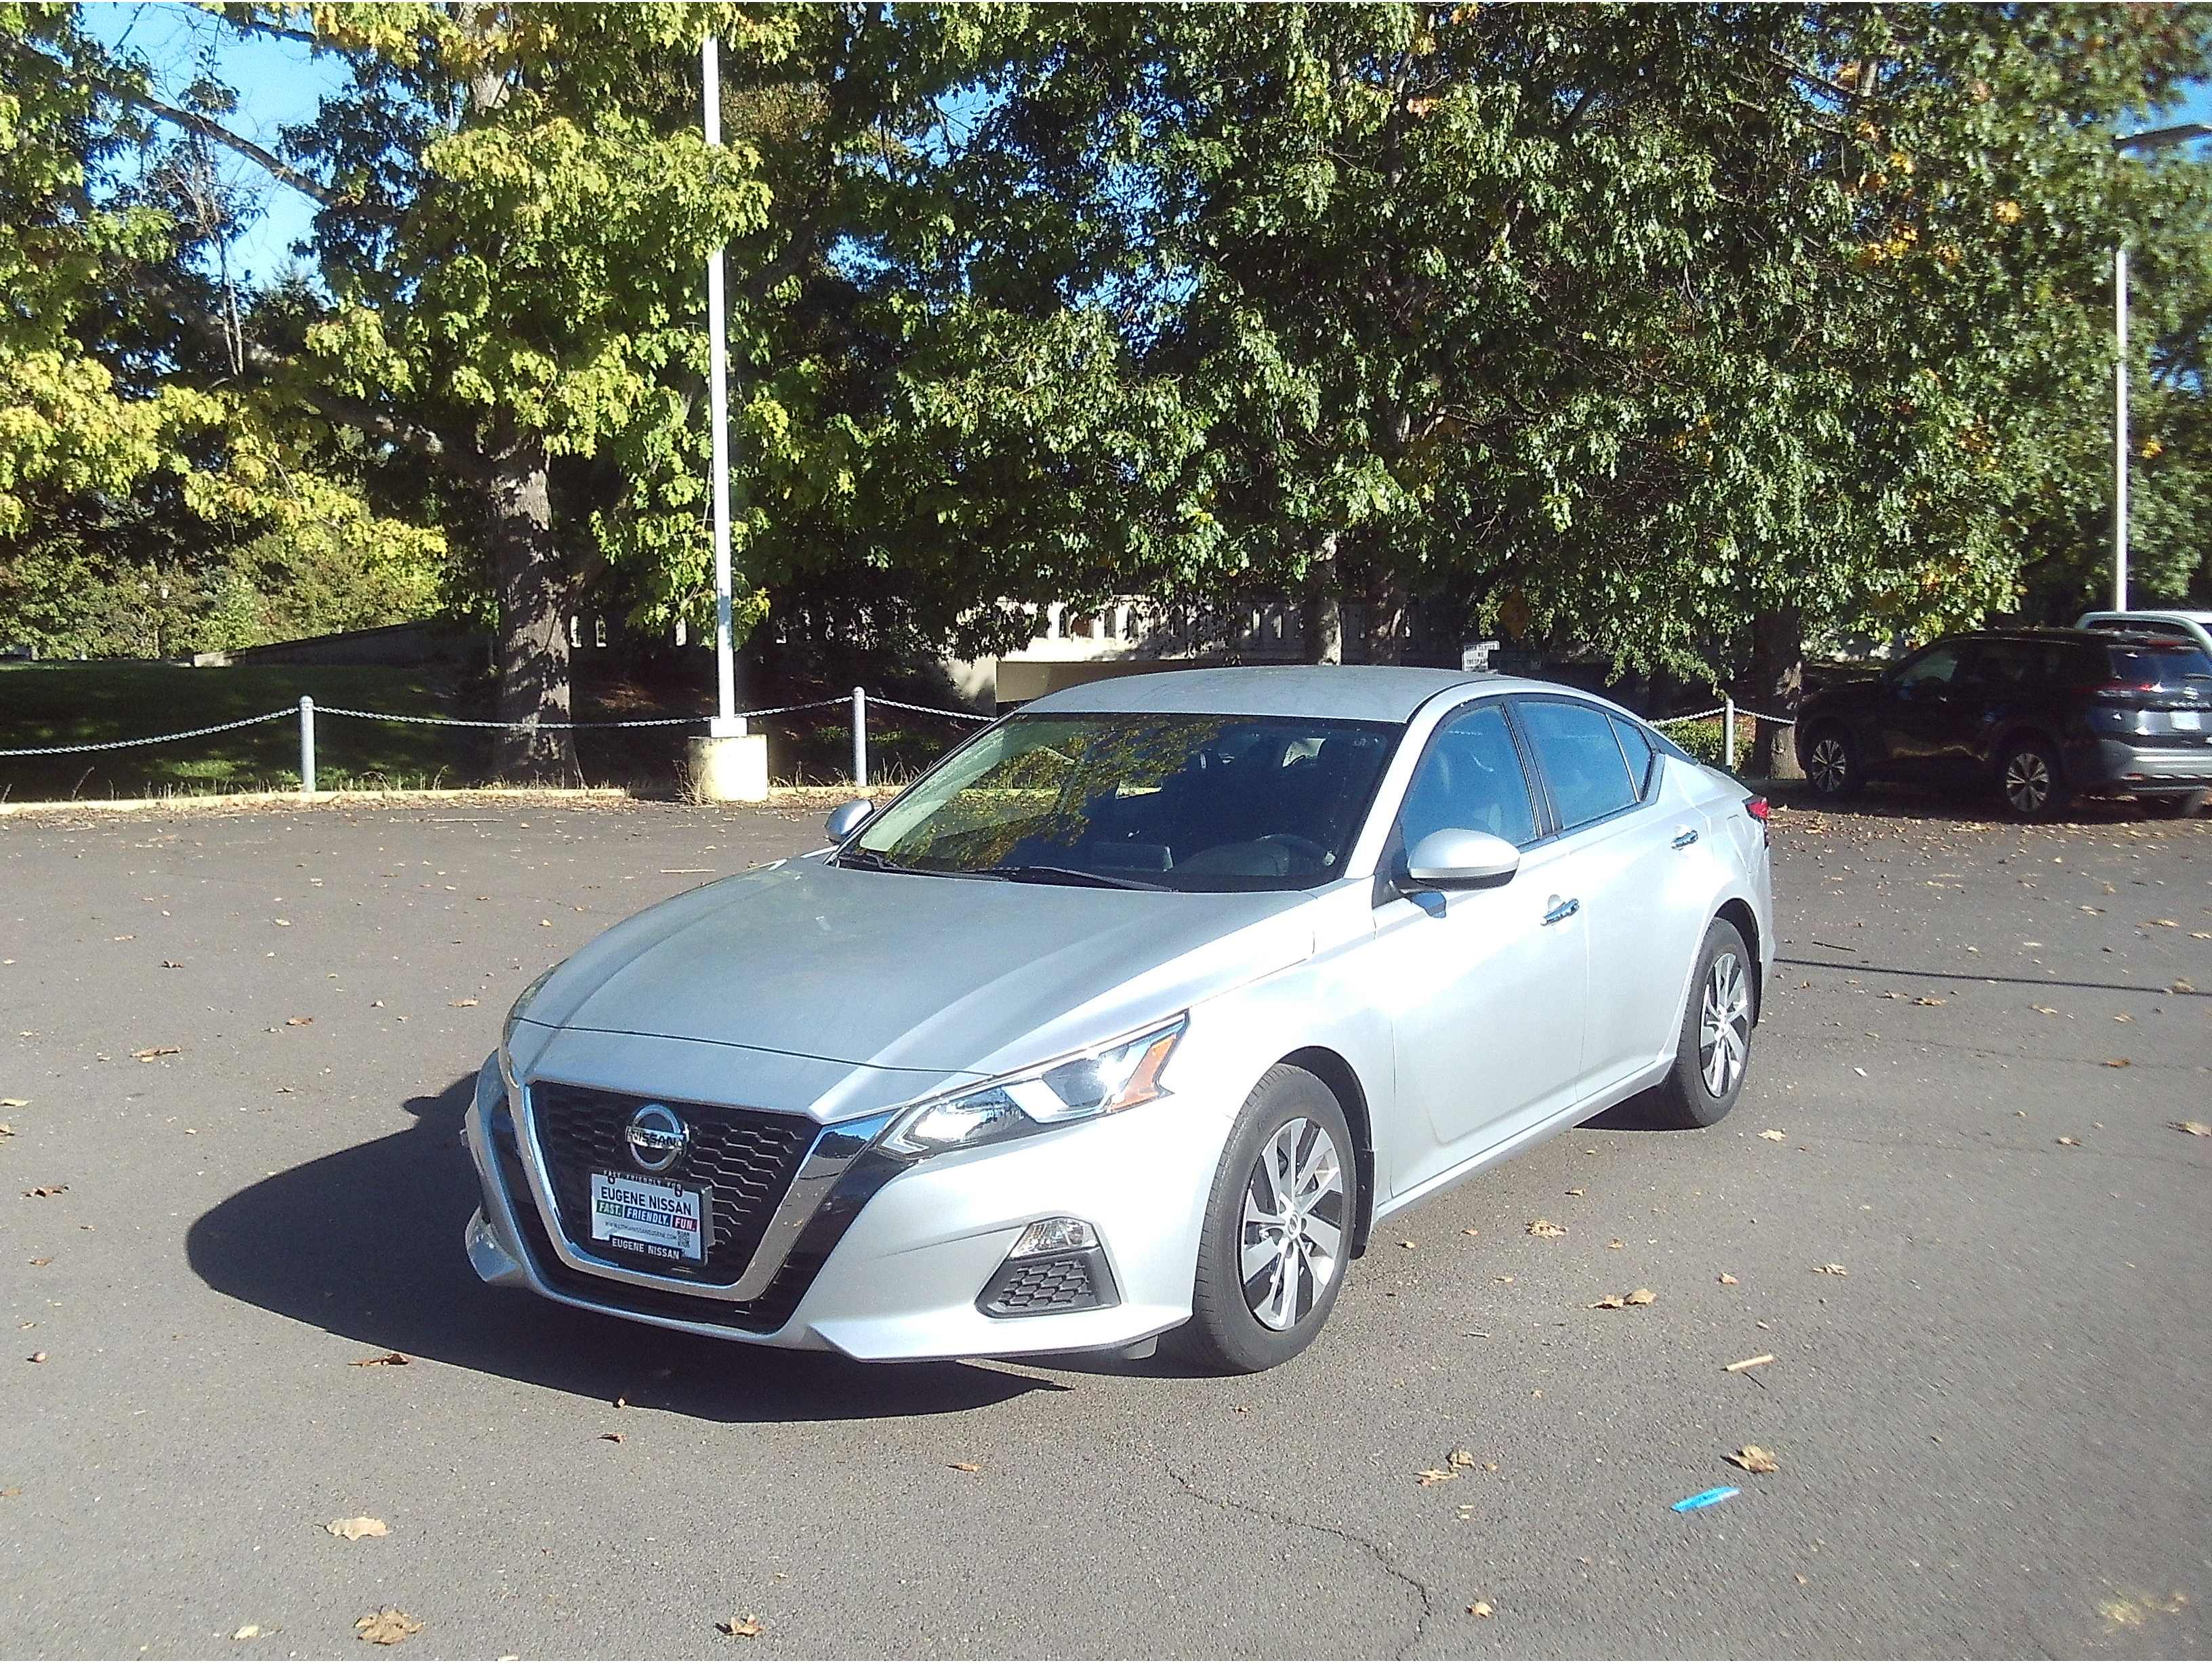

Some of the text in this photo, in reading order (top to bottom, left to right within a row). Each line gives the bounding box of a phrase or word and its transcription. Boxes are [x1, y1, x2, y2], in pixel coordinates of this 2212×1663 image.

[630, 1130, 677, 1147] NISSAN
[601, 1186, 692, 1216] EUGENE NISSAN
[598, 1202, 695, 1231] FAST. FRIENDLY. FUN.
[612, 1238, 680, 1260] EUGENE NISSAN
